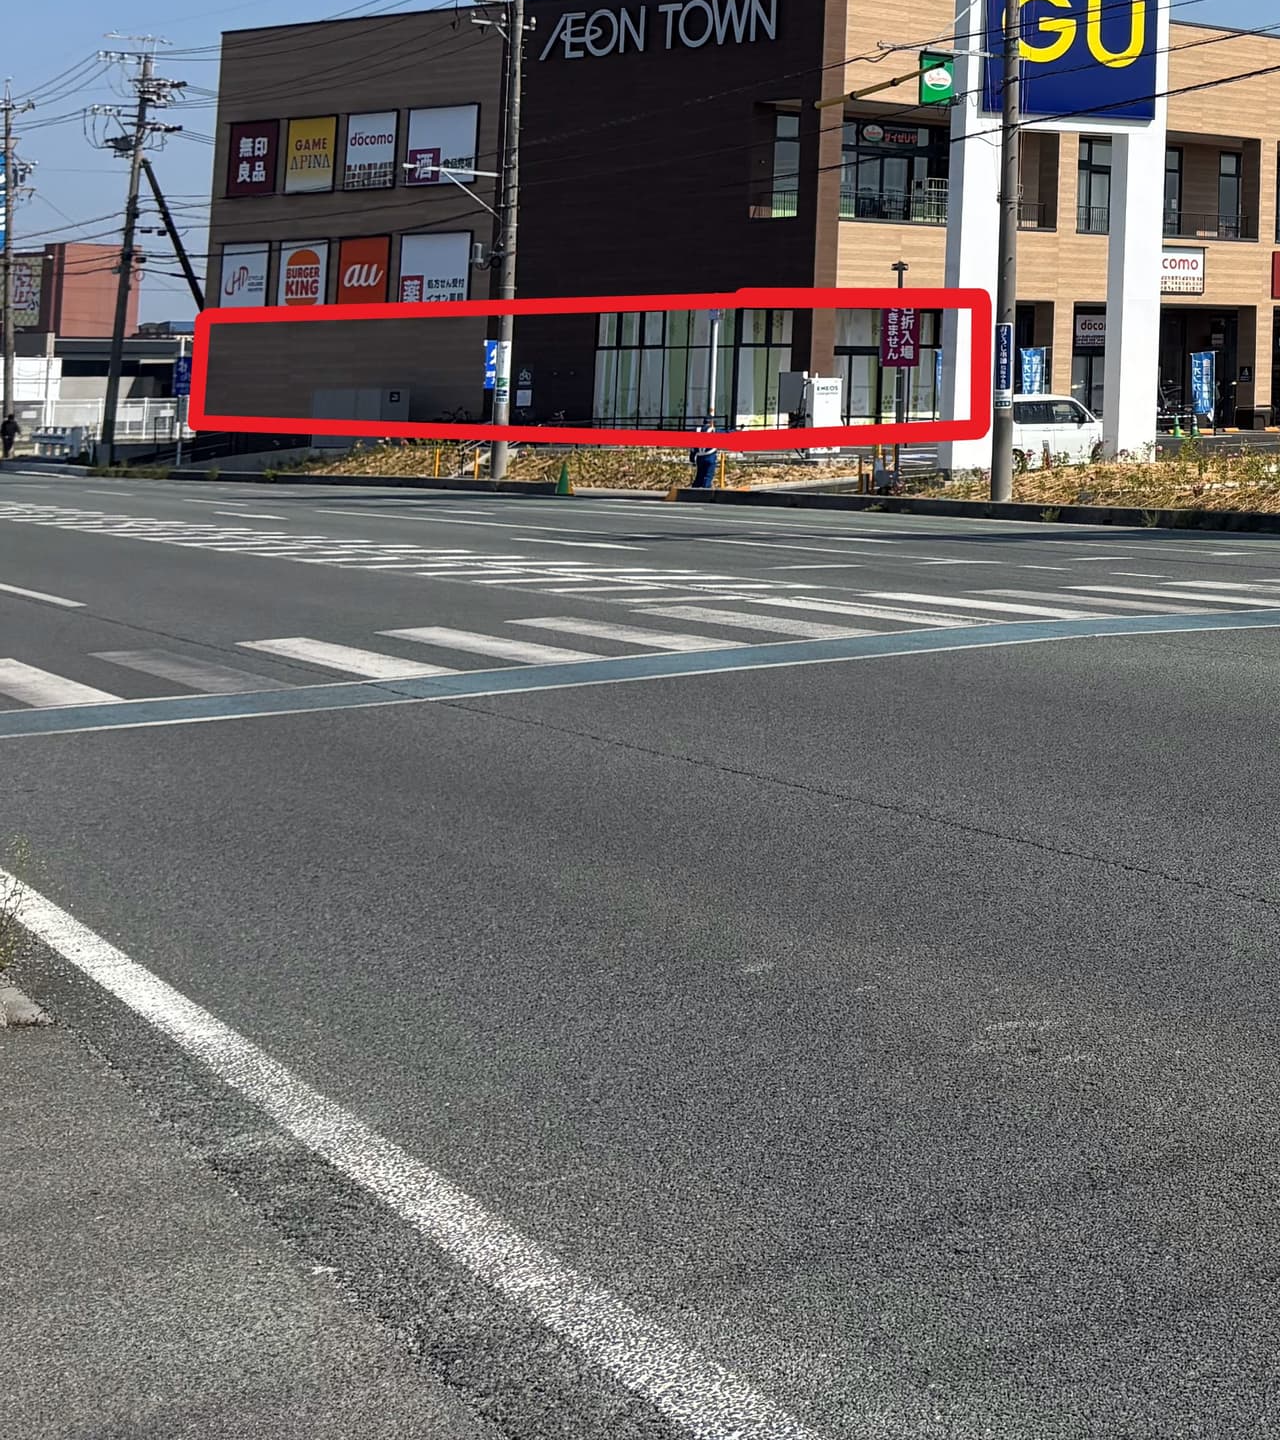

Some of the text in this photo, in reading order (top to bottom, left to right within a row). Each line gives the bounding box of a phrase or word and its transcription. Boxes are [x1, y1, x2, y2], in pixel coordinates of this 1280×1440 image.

[239, 136, 269, 158] 無印
[294, 137, 328, 151] GAME
[350, 131, 394, 148] docomo
[236, 162, 267, 185] 良品
[286, 266, 320, 279] BURGER
[343, 263, 384, 288] au
[285, 279, 319, 296] KING
[1080, 319, 1106, 331] doco
[887, 308, 899, 360] きません
